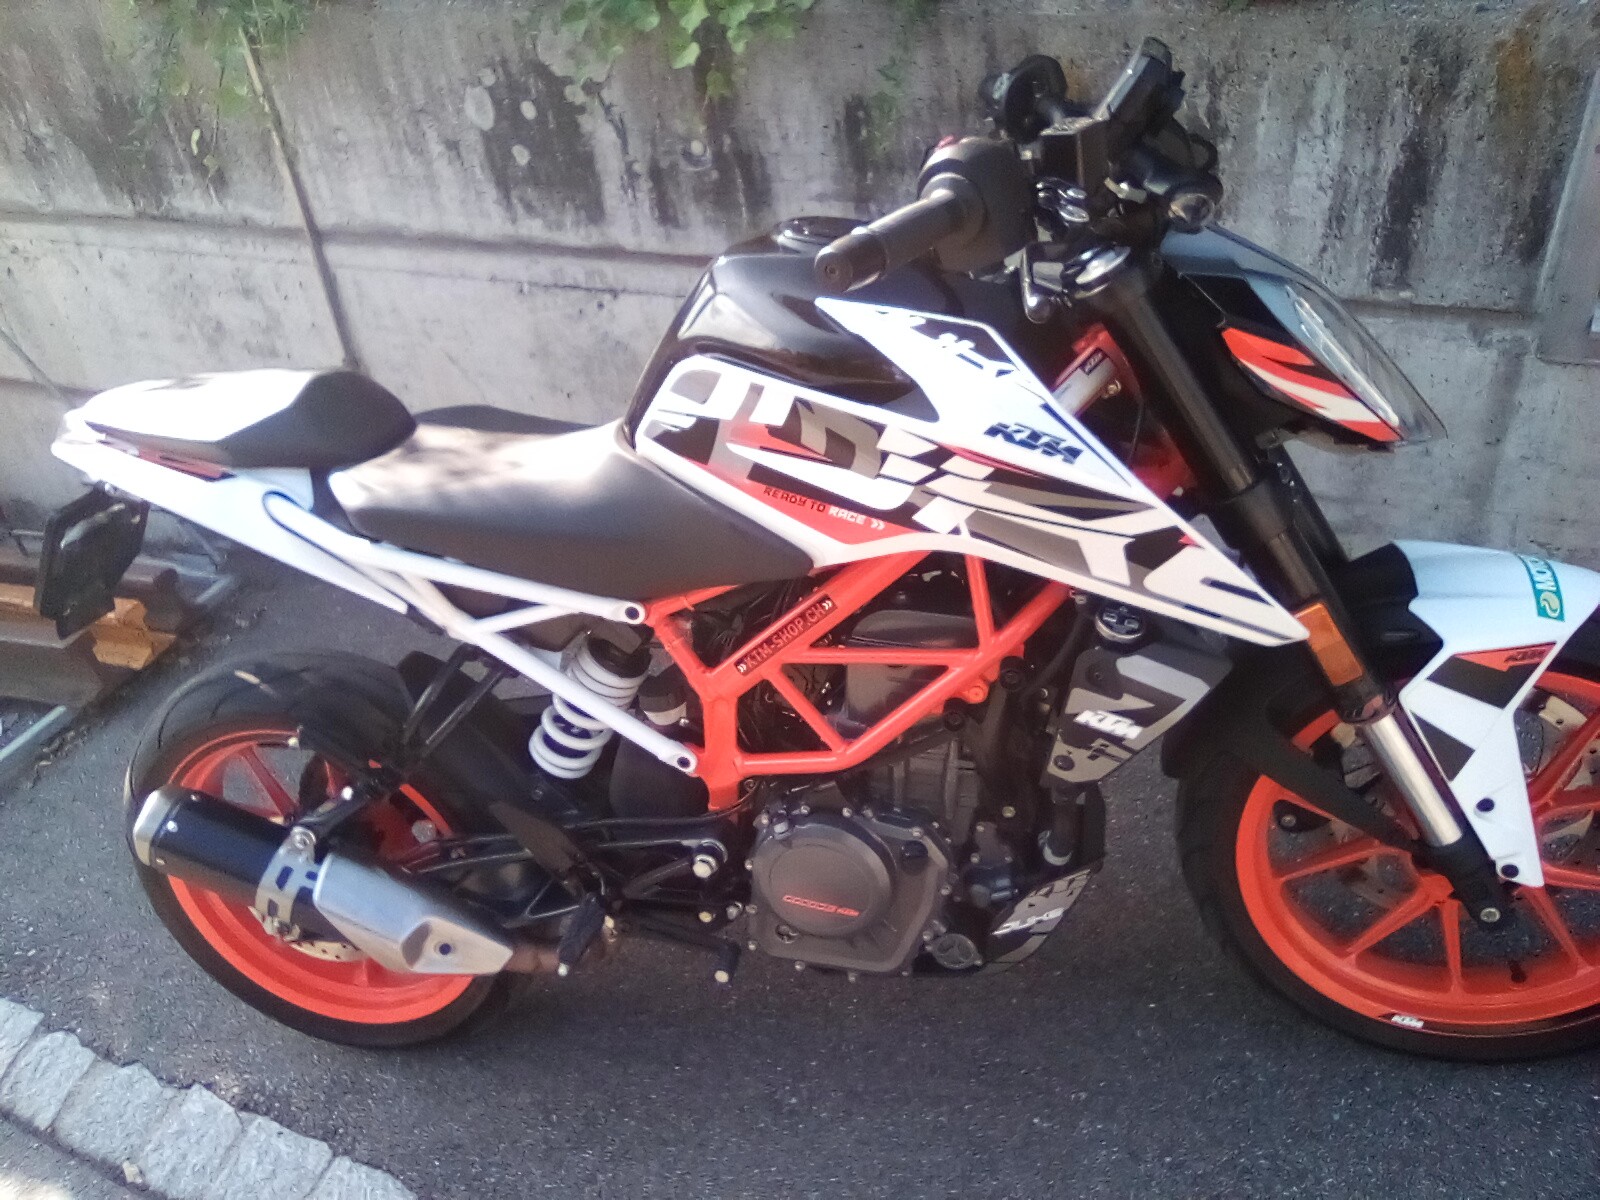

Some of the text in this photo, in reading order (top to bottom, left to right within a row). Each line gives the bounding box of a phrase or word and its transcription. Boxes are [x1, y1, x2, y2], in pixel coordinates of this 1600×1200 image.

[983, 422, 1084, 465] KTM
[763, 485, 867, 525] READY TO RACE
[744, 603, 826, 668] KTM-SHOP.CH
[1073, 709, 1143, 740] KTM
[1391, 1014, 1424, 1029] KTM
